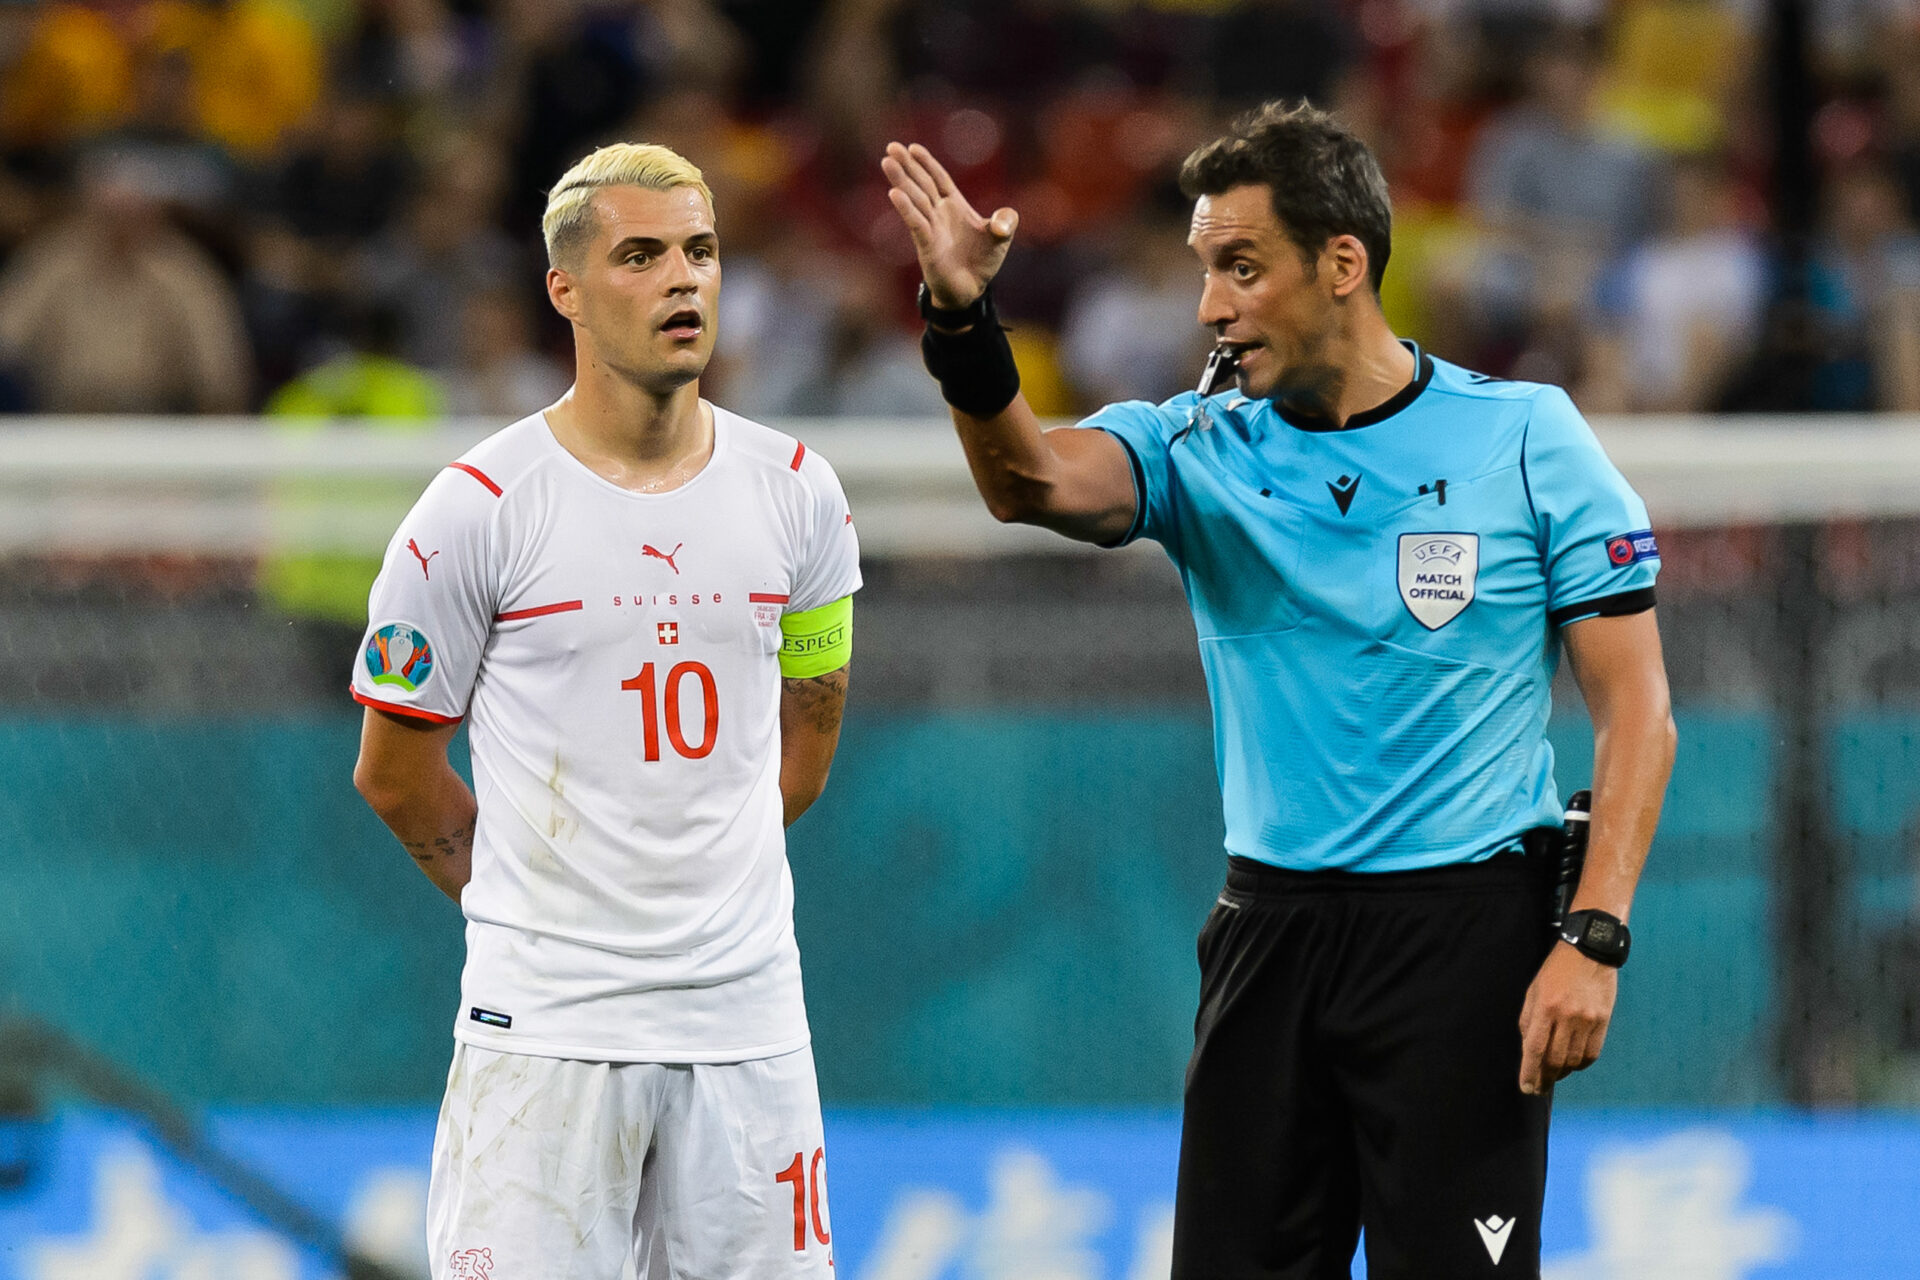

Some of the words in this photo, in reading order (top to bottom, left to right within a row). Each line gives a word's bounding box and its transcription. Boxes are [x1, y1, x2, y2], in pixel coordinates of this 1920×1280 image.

[1415, 544, 1462, 562] UEFA
[1416, 573, 1461, 585] MATCH
[613, 593, 722, 606] suisse
[1409, 588, 1465, 601] OFFICIAL
[782, 626, 844, 652] ESPECT
[621, 660, 719, 762] 10
[775, 1146, 830, 1251] 10
